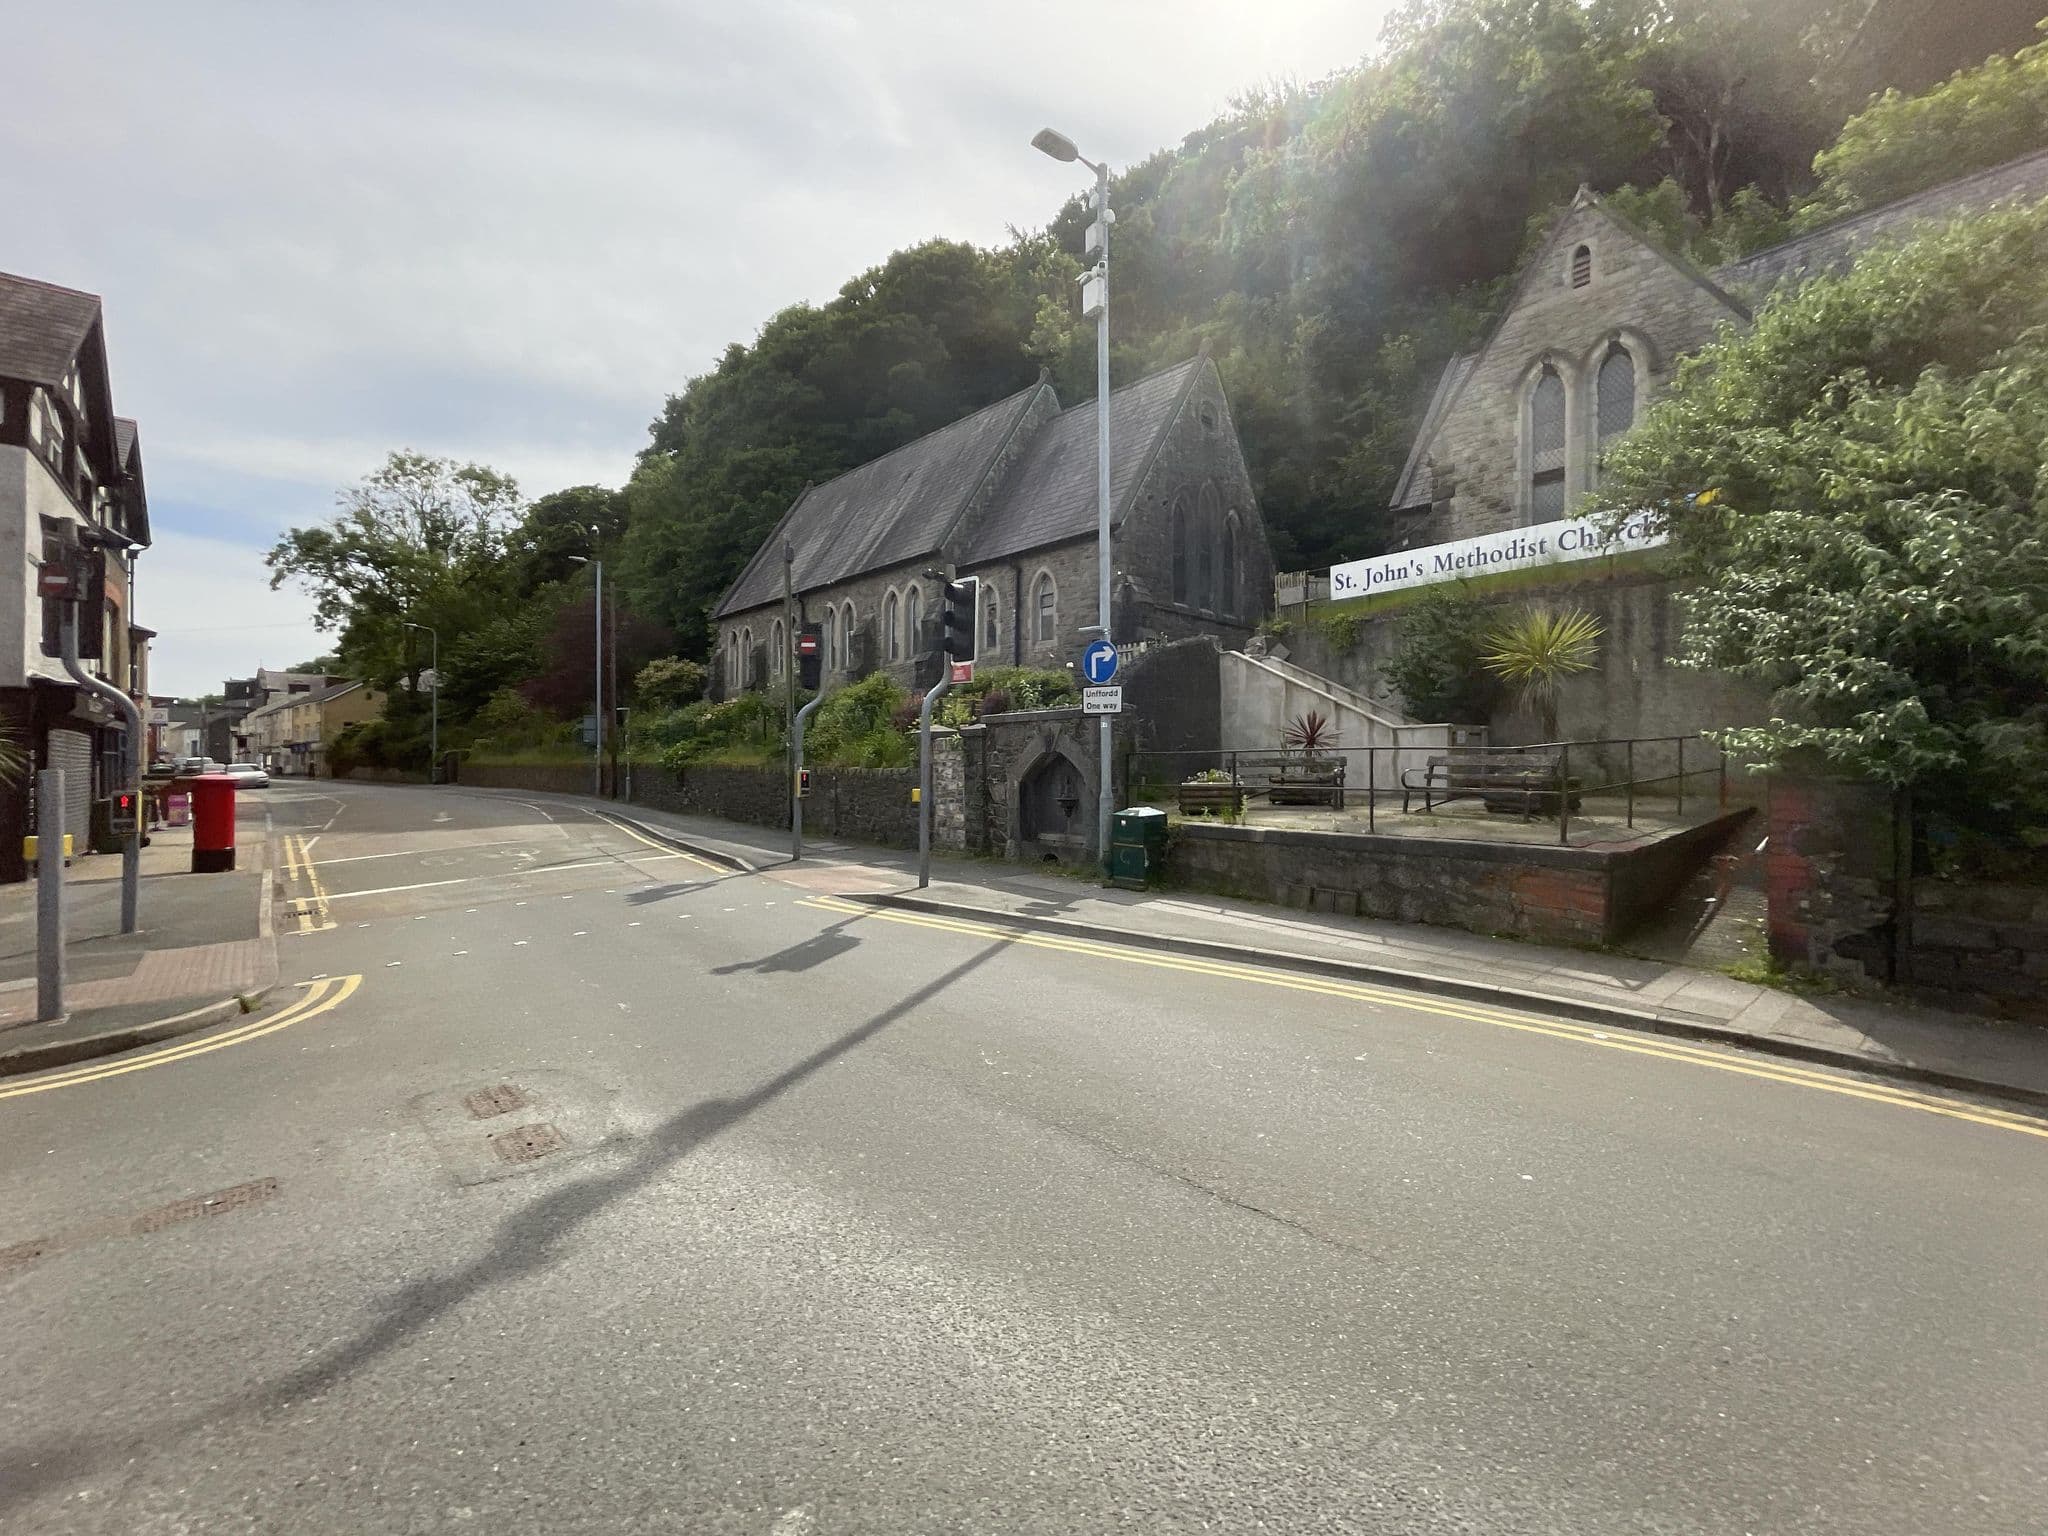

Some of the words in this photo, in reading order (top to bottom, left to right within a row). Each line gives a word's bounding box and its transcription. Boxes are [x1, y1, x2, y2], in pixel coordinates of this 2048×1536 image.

[1335, 573, 1357, 591] St.
[1362, 559, 1424, 592] John's
[1432, 537, 1548, 574] Methodist
[1086, 689, 1118, 697] Unffordd
